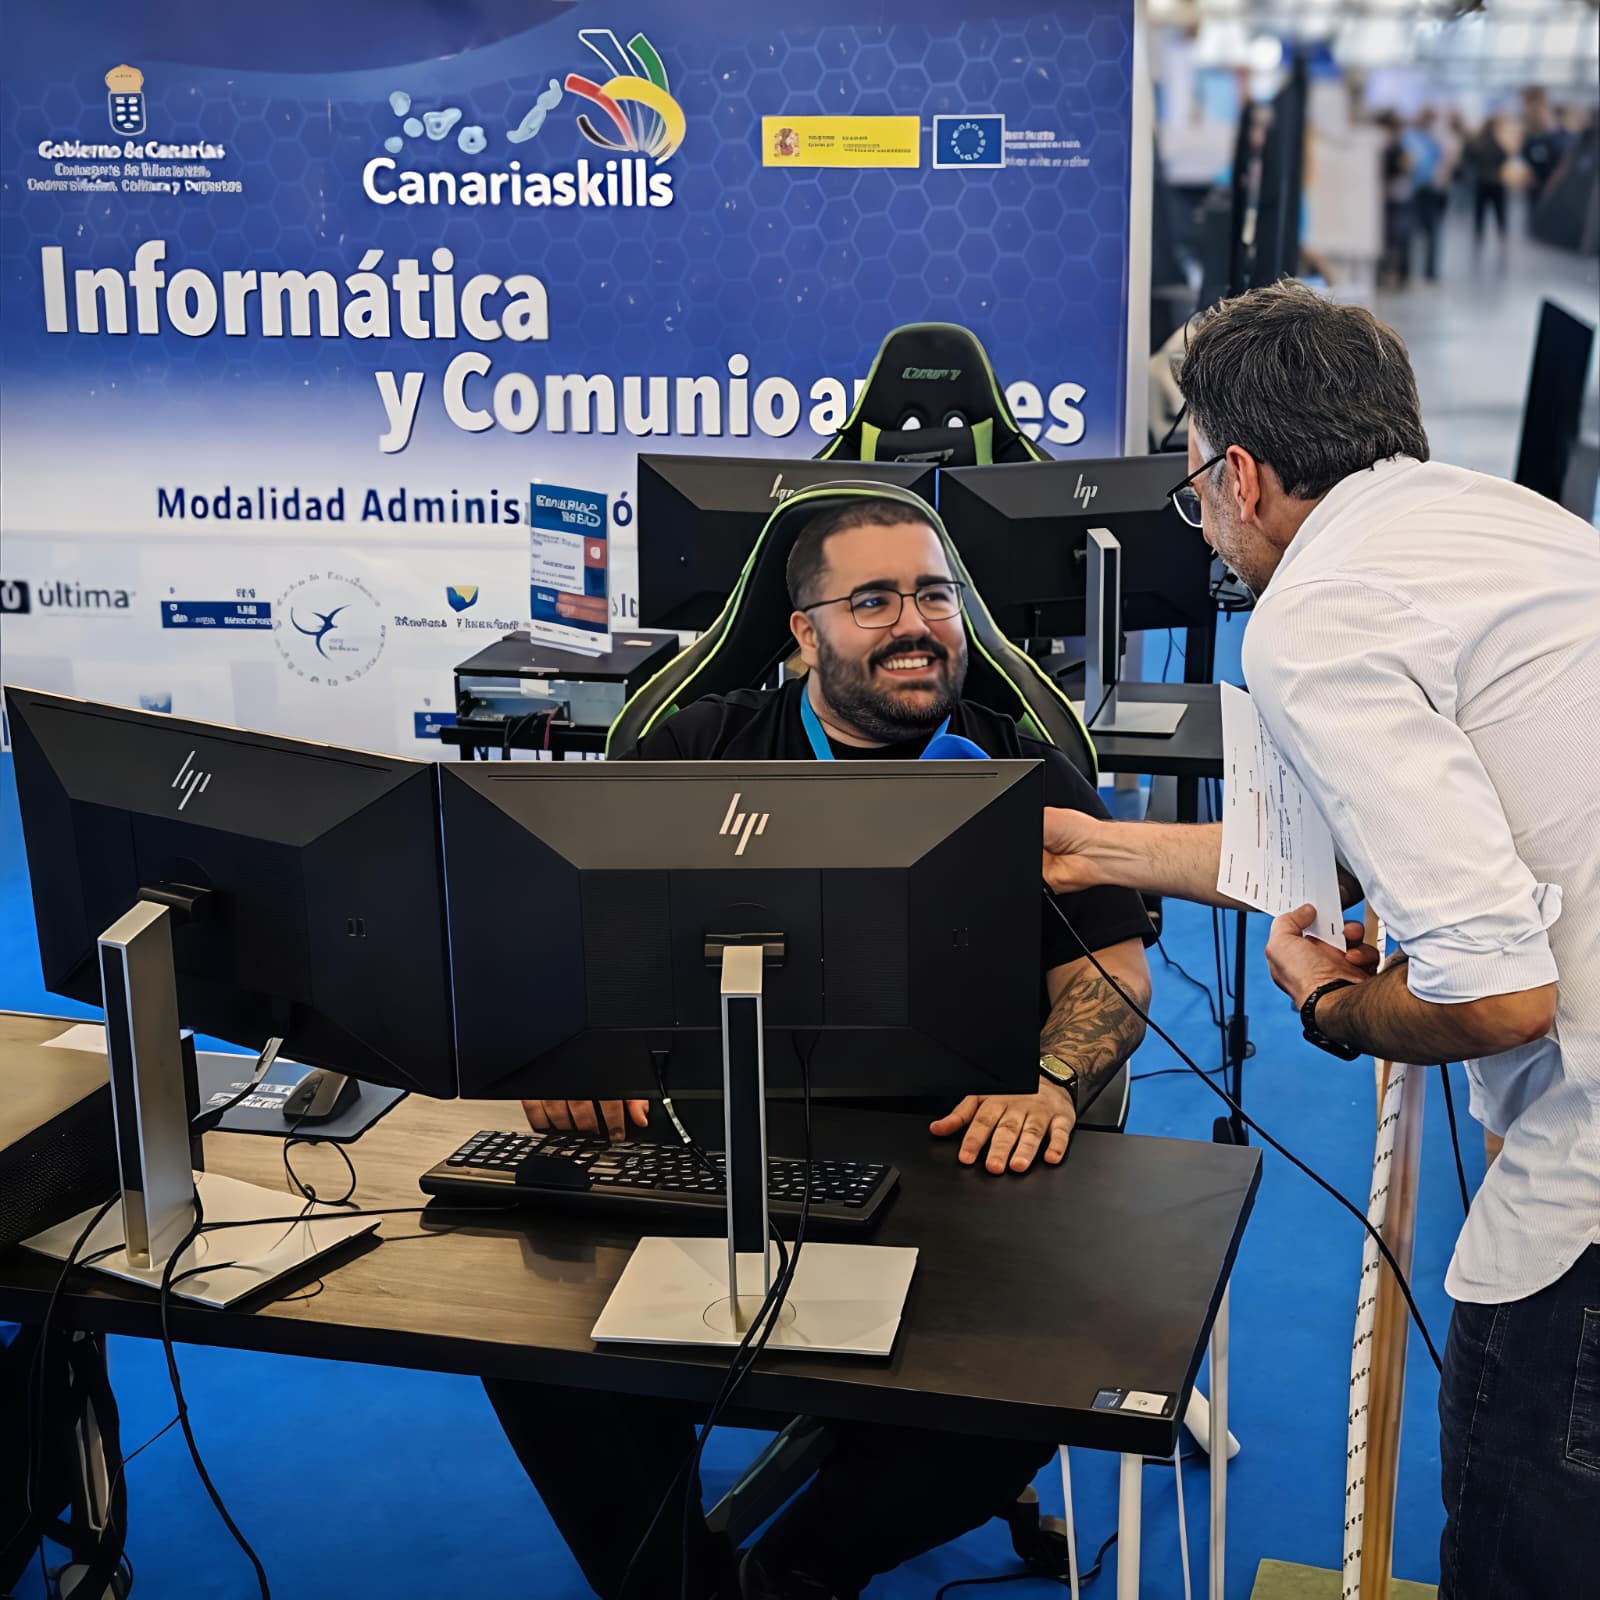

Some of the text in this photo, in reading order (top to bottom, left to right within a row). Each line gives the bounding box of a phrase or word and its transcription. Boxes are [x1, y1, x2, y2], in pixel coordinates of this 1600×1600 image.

[362, 156, 674, 207] Canariaskills
[41, 240, 550, 342] Informática
[375, 370, 425, 454] y
[157, 486, 345, 521] Modalidad
[38, 580, 130, 609] última
[719, 793, 770, 855] hp
